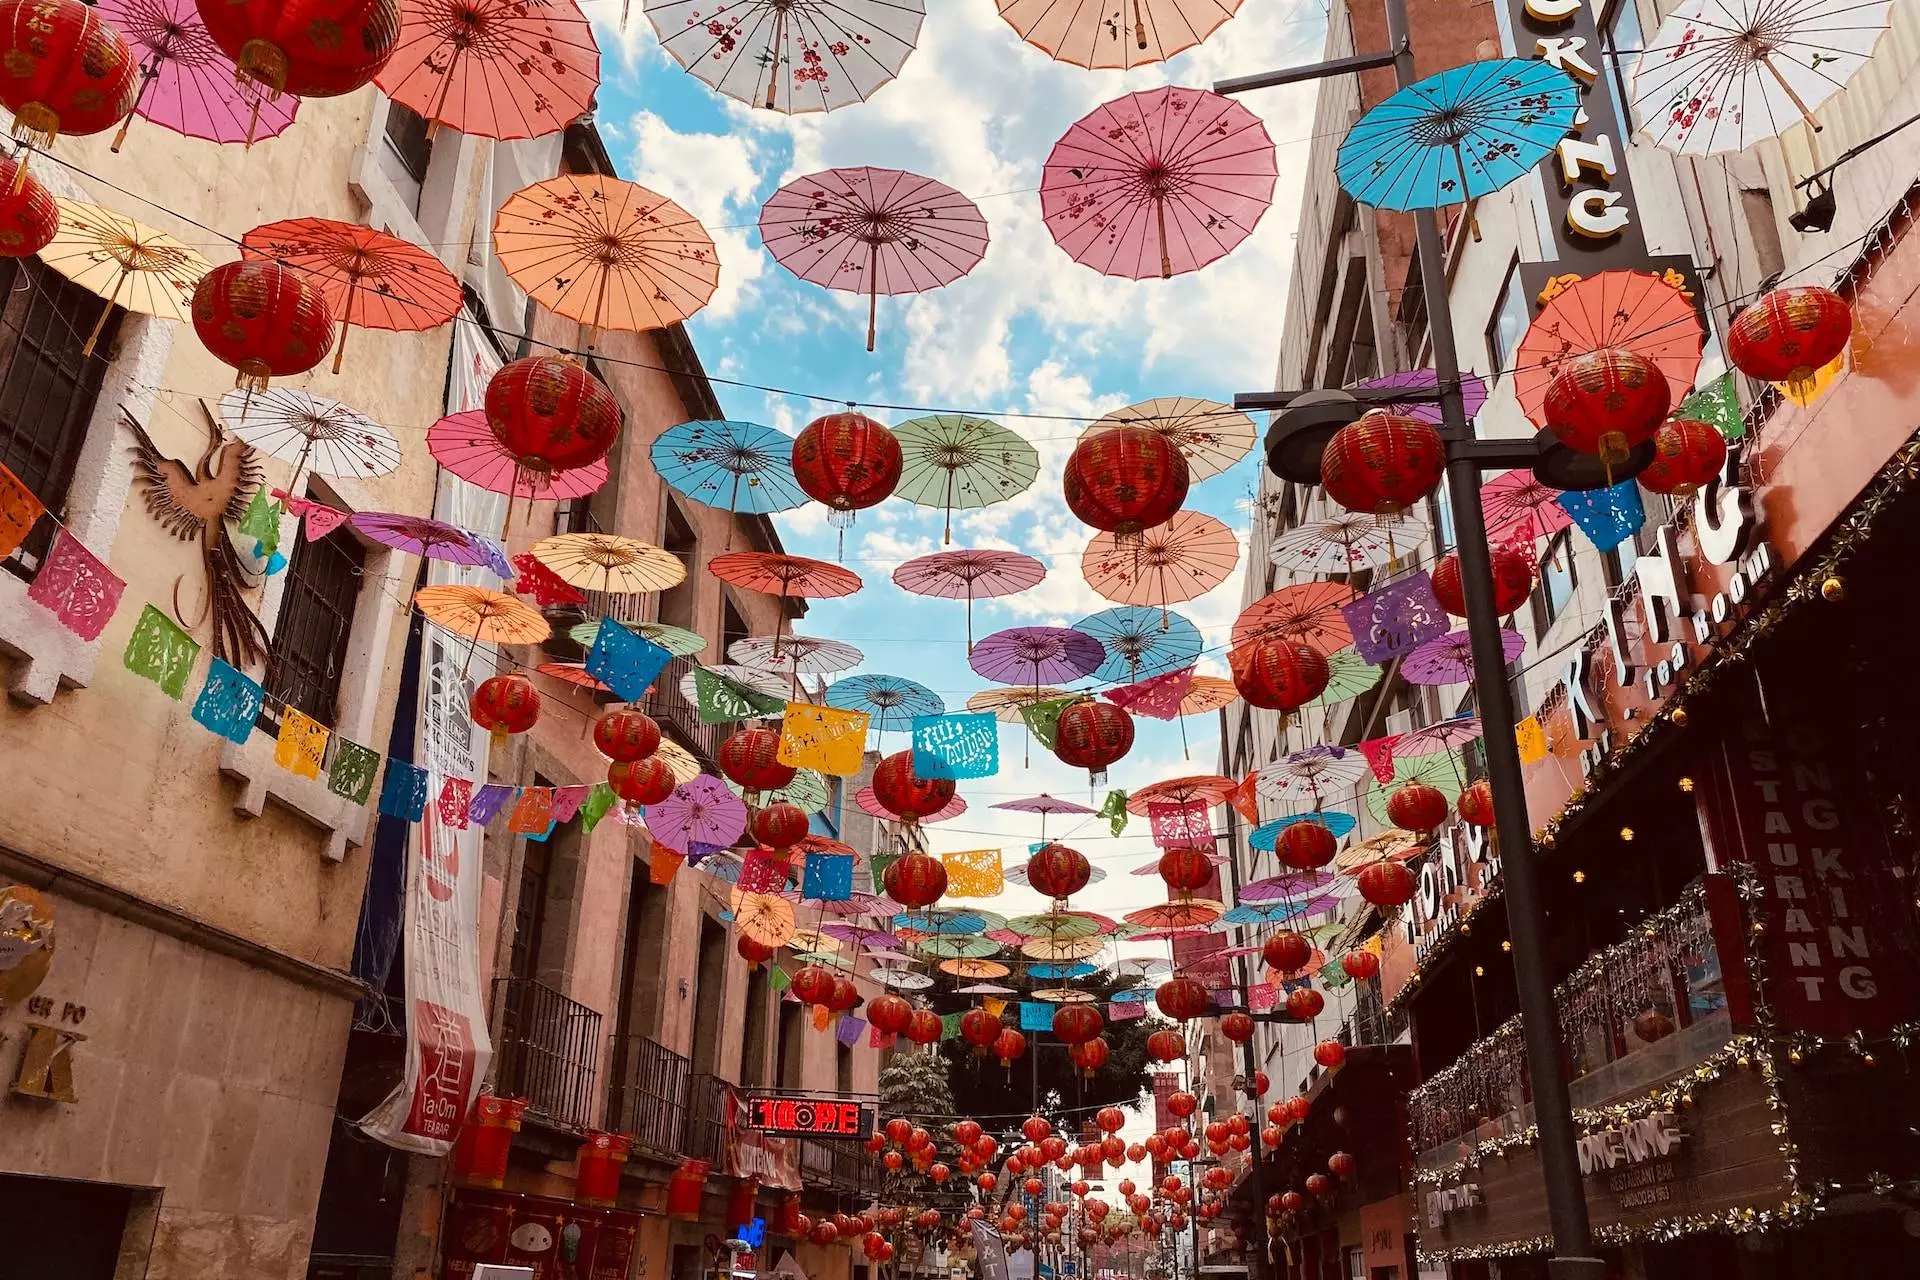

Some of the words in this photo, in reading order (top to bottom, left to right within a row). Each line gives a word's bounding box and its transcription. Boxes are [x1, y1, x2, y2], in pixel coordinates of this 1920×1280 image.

[1536, 37, 1630, 235] KNG
[1579, 729, 1610, 777] Bar
[1643, 642, 1684, 700] Tea
[1692, 542, 1769, 645] Room
[1811, 847, 1879, 1001] KING
